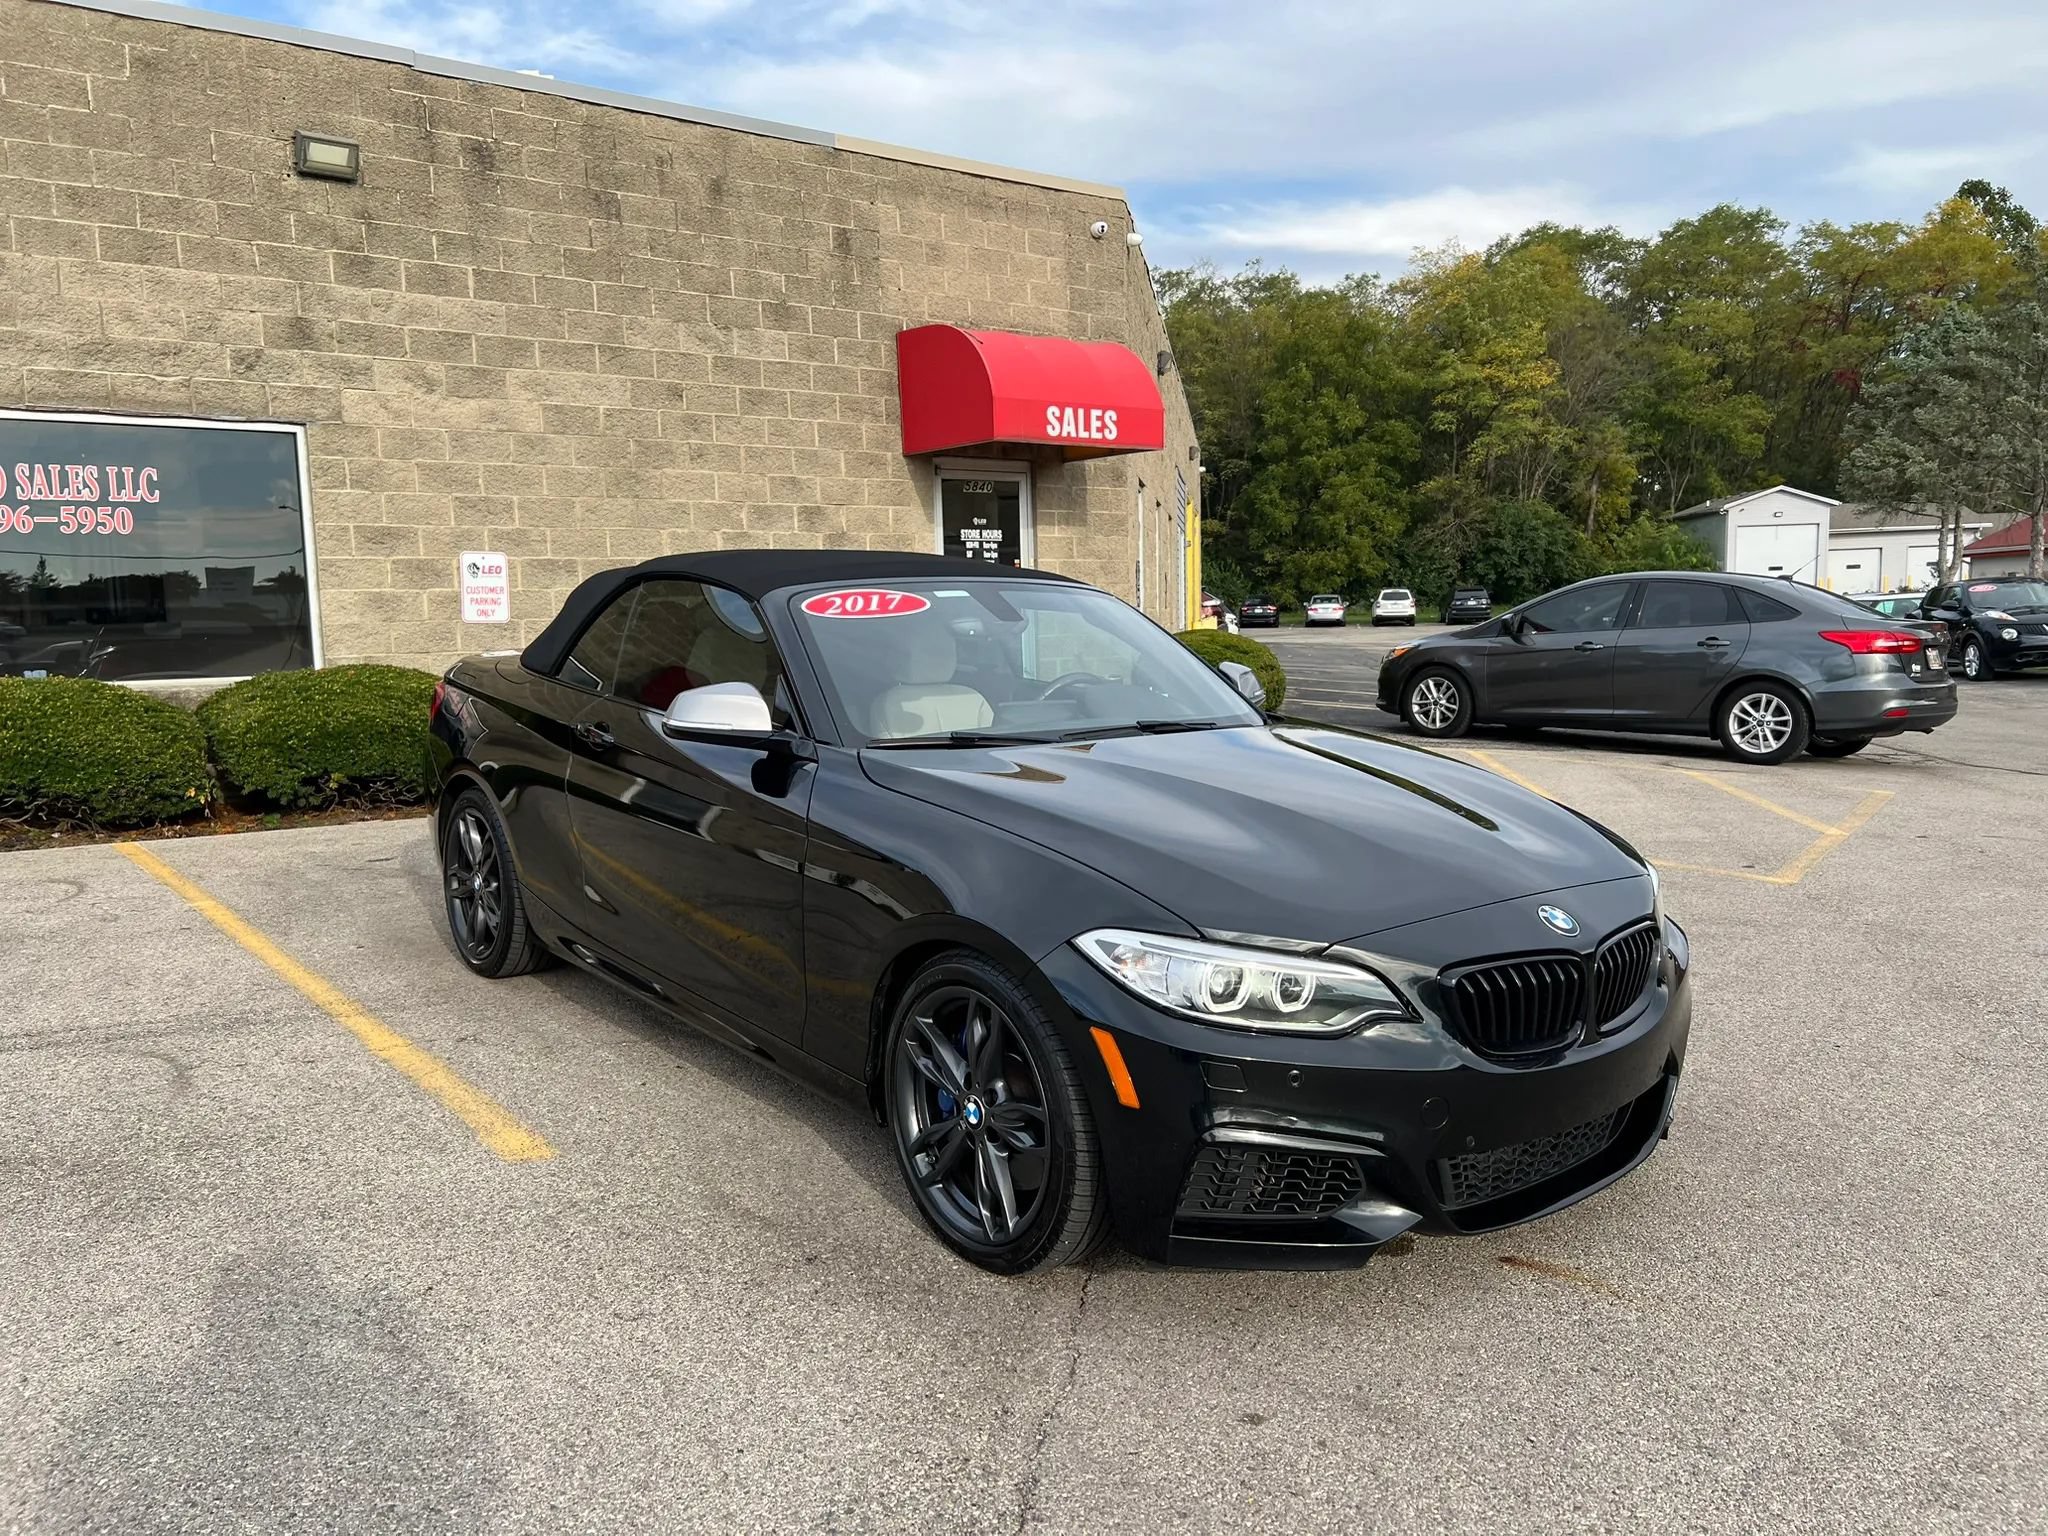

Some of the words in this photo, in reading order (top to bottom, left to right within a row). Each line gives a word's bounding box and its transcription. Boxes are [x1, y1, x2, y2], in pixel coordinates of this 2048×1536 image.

[1046, 405, 1118, 440] SALES
[15, 463, 100, 500] SALES
[106, 466, 160, 503] LLC
[964, 480, 993, 492] 5840
[960, 529, 981, 539] STORE
[981, 530, 1003, 540] HOURS
[481, 565, 503, 575] LEO
[465, 586, 505, 595] CUSTOMER
[470, 597, 502, 606] PARKING
[824, 593, 903, 615] 2017
[476, 608, 496, 617] ONLY
